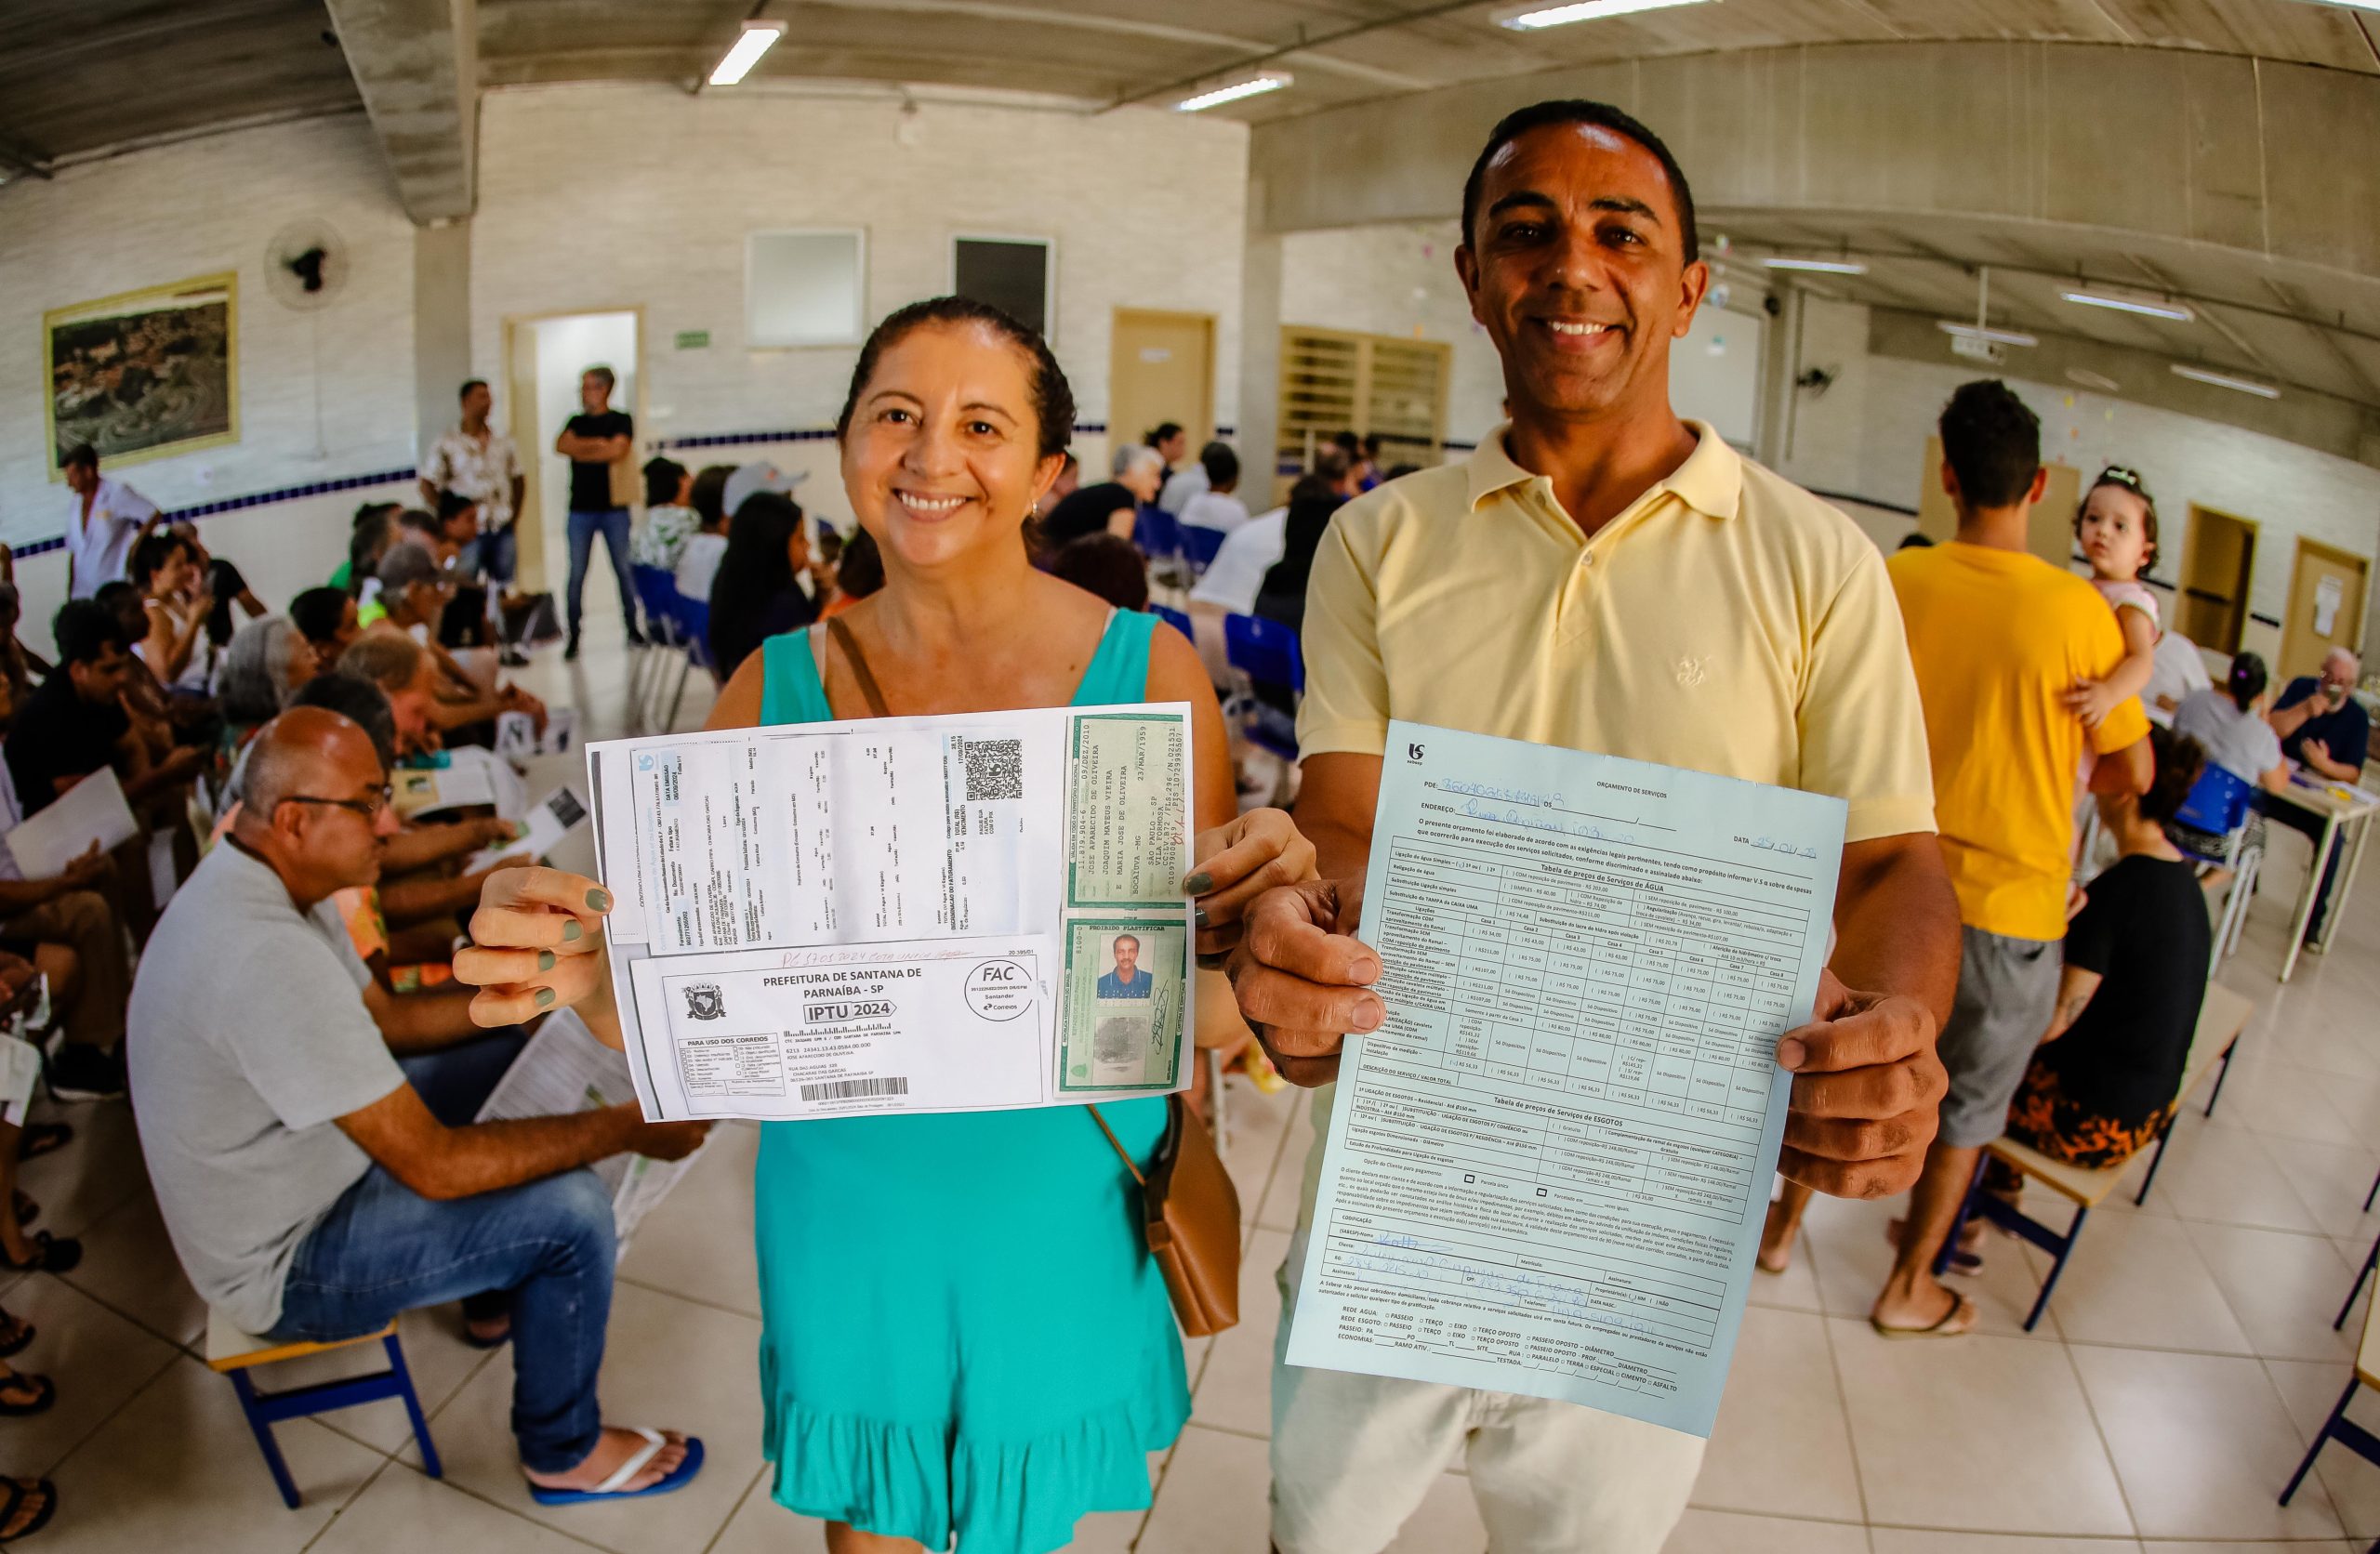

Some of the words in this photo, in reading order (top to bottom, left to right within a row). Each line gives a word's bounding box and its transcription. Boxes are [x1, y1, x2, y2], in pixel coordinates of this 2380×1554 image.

[1091, 744, 1099, 784] OLIVEIRA
[1091, 789, 1097, 799] DE
[1118, 765, 1127, 805] OLIVEIRA
[1596, 781, 1632, 792] ORÇAMENTO
[1641, 789, 1667, 798] SERVIÇOS
[1150, 796, 1157, 806] SP
[1421, 802, 1457, 815] ENDEREÇO:
[1118, 810, 1125, 820] DE
[1424, 820, 1451, 828] presente
[1452, 824, 1485, 835] orçamento
[1494, 831, 1525, 841] elaborado
[1534, 838, 1555, 847] acordo
[1577, 846, 1607, 856] exigências
[1608, 850, 1626, 859] legais
[1626, 855, 1662, 866] pertinentes,
[1663, 861, 1681, 869] tendo
[1698, 868, 1726, 877] propósito
[1726, 873, 1752, 882] informar
[1733, 836, 1749, 844] DATA
[1102, 839, 1110, 875] JOAQUIM
[1429, 831, 1460, 840] ocorrerão
[1475, 838, 1503, 848] execução
[1516, 846, 1540, 854] serviços
[1540, 849, 1573, 861] solicitados,
[1575, 856, 1604, 865] conforme
[1605, 861, 1644, 873] discriminado
[1649, 869, 1680, 879] assinalado
[1681, 875, 1702, 883] abaixo:
[1540, 863, 1562, 874] Tabela
[1572, 871, 1594, 881] preços
[1596, 874, 1605, 883] de
[1606, 876, 1633, 887] Serviços
[1644, 881, 1663, 891] ÁGUA
[763, 973, 830, 986] PREFEITURA
[832, 971, 847, 981] DE
[850, 969, 904, 981] SANTANA
[906, 968, 921, 977] DE
[983, 966, 1014, 981] FAC
[803, 984, 861, 998] PARNAÍBA
[870, 984, 883, 994] SP
[808, 1005, 850, 1021] IPTU
[853, 1002, 890, 1017] 2024
[1494, 1096, 1514, 1106] Tabela
[1524, 1104, 1546, 1113] preços
[1556, 1109, 1582, 1119] Serviços
[1593, 1115, 1622, 1126] ESGOTOS
[1357, 1317, 1382, 1326] ESGOTO:
[1388, 1322, 1412, 1330] PASSEIO
[1476, 1336, 1495, 1344] TERÇO
[1496, 1338, 1519, 1348] OPOSTO
[1529, 1344, 1553, 1352] PASSEIO
[1553, 1348, 1576, 1357] OPOSTO
[1616, 1362, 1647, 1375] DIAMETRO
[1390, 1312, 1413, 1322] PASSEIO
[1424, 1318, 1443, 1326] TERÇO
[1478, 1326, 1497, 1335] TERÇO
[1497, 1330, 1521, 1339] OPOSTO
[1531, 1336, 1554, 1344] PASSEIO
[1554, 1339, 1579, 1349] OPOSTO
[1584, 1345, 1615, 1358] DIÂMETRO
[1531, 1353, 1559, 1363] PARALELO
[1566, 1360, 1583, 1368] TERRA
[1590, 1364, 1614, 1376] ESPECIAL
[1620, 1372, 1646, 1383] CIMENTO
[1652, 1380, 1677, 1391] ASFALTO
